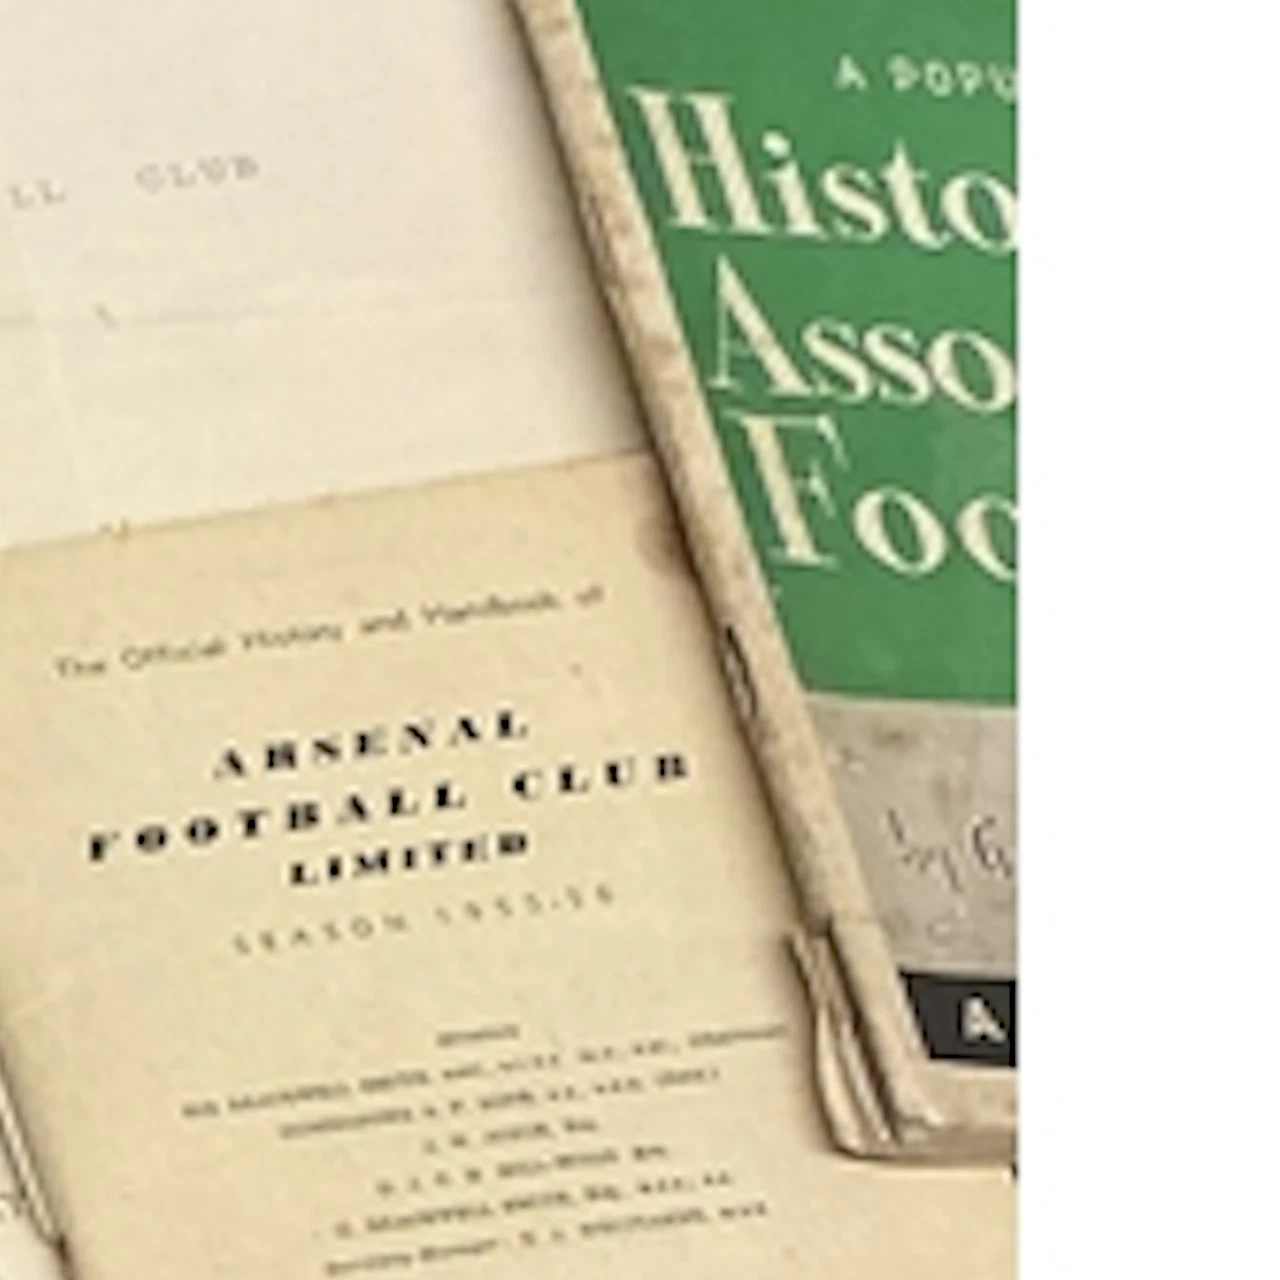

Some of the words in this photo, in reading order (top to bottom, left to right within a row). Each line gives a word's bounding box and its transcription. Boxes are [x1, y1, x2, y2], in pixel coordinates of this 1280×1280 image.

[836, 53, 868, 91] A
[136, 154, 261, 196] CLUB
[625, 85, 1017, 255] Histo
[707, 253, 1016, 416] Asso
[214, 710, 530, 780] ARSENAL
[86, 781, 468, 864] FOOTBALL
[510, 752, 691, 801] CLUB
[288, 831, 531, 887] LIMITED
[234, 915, 410, 956] SEASON
